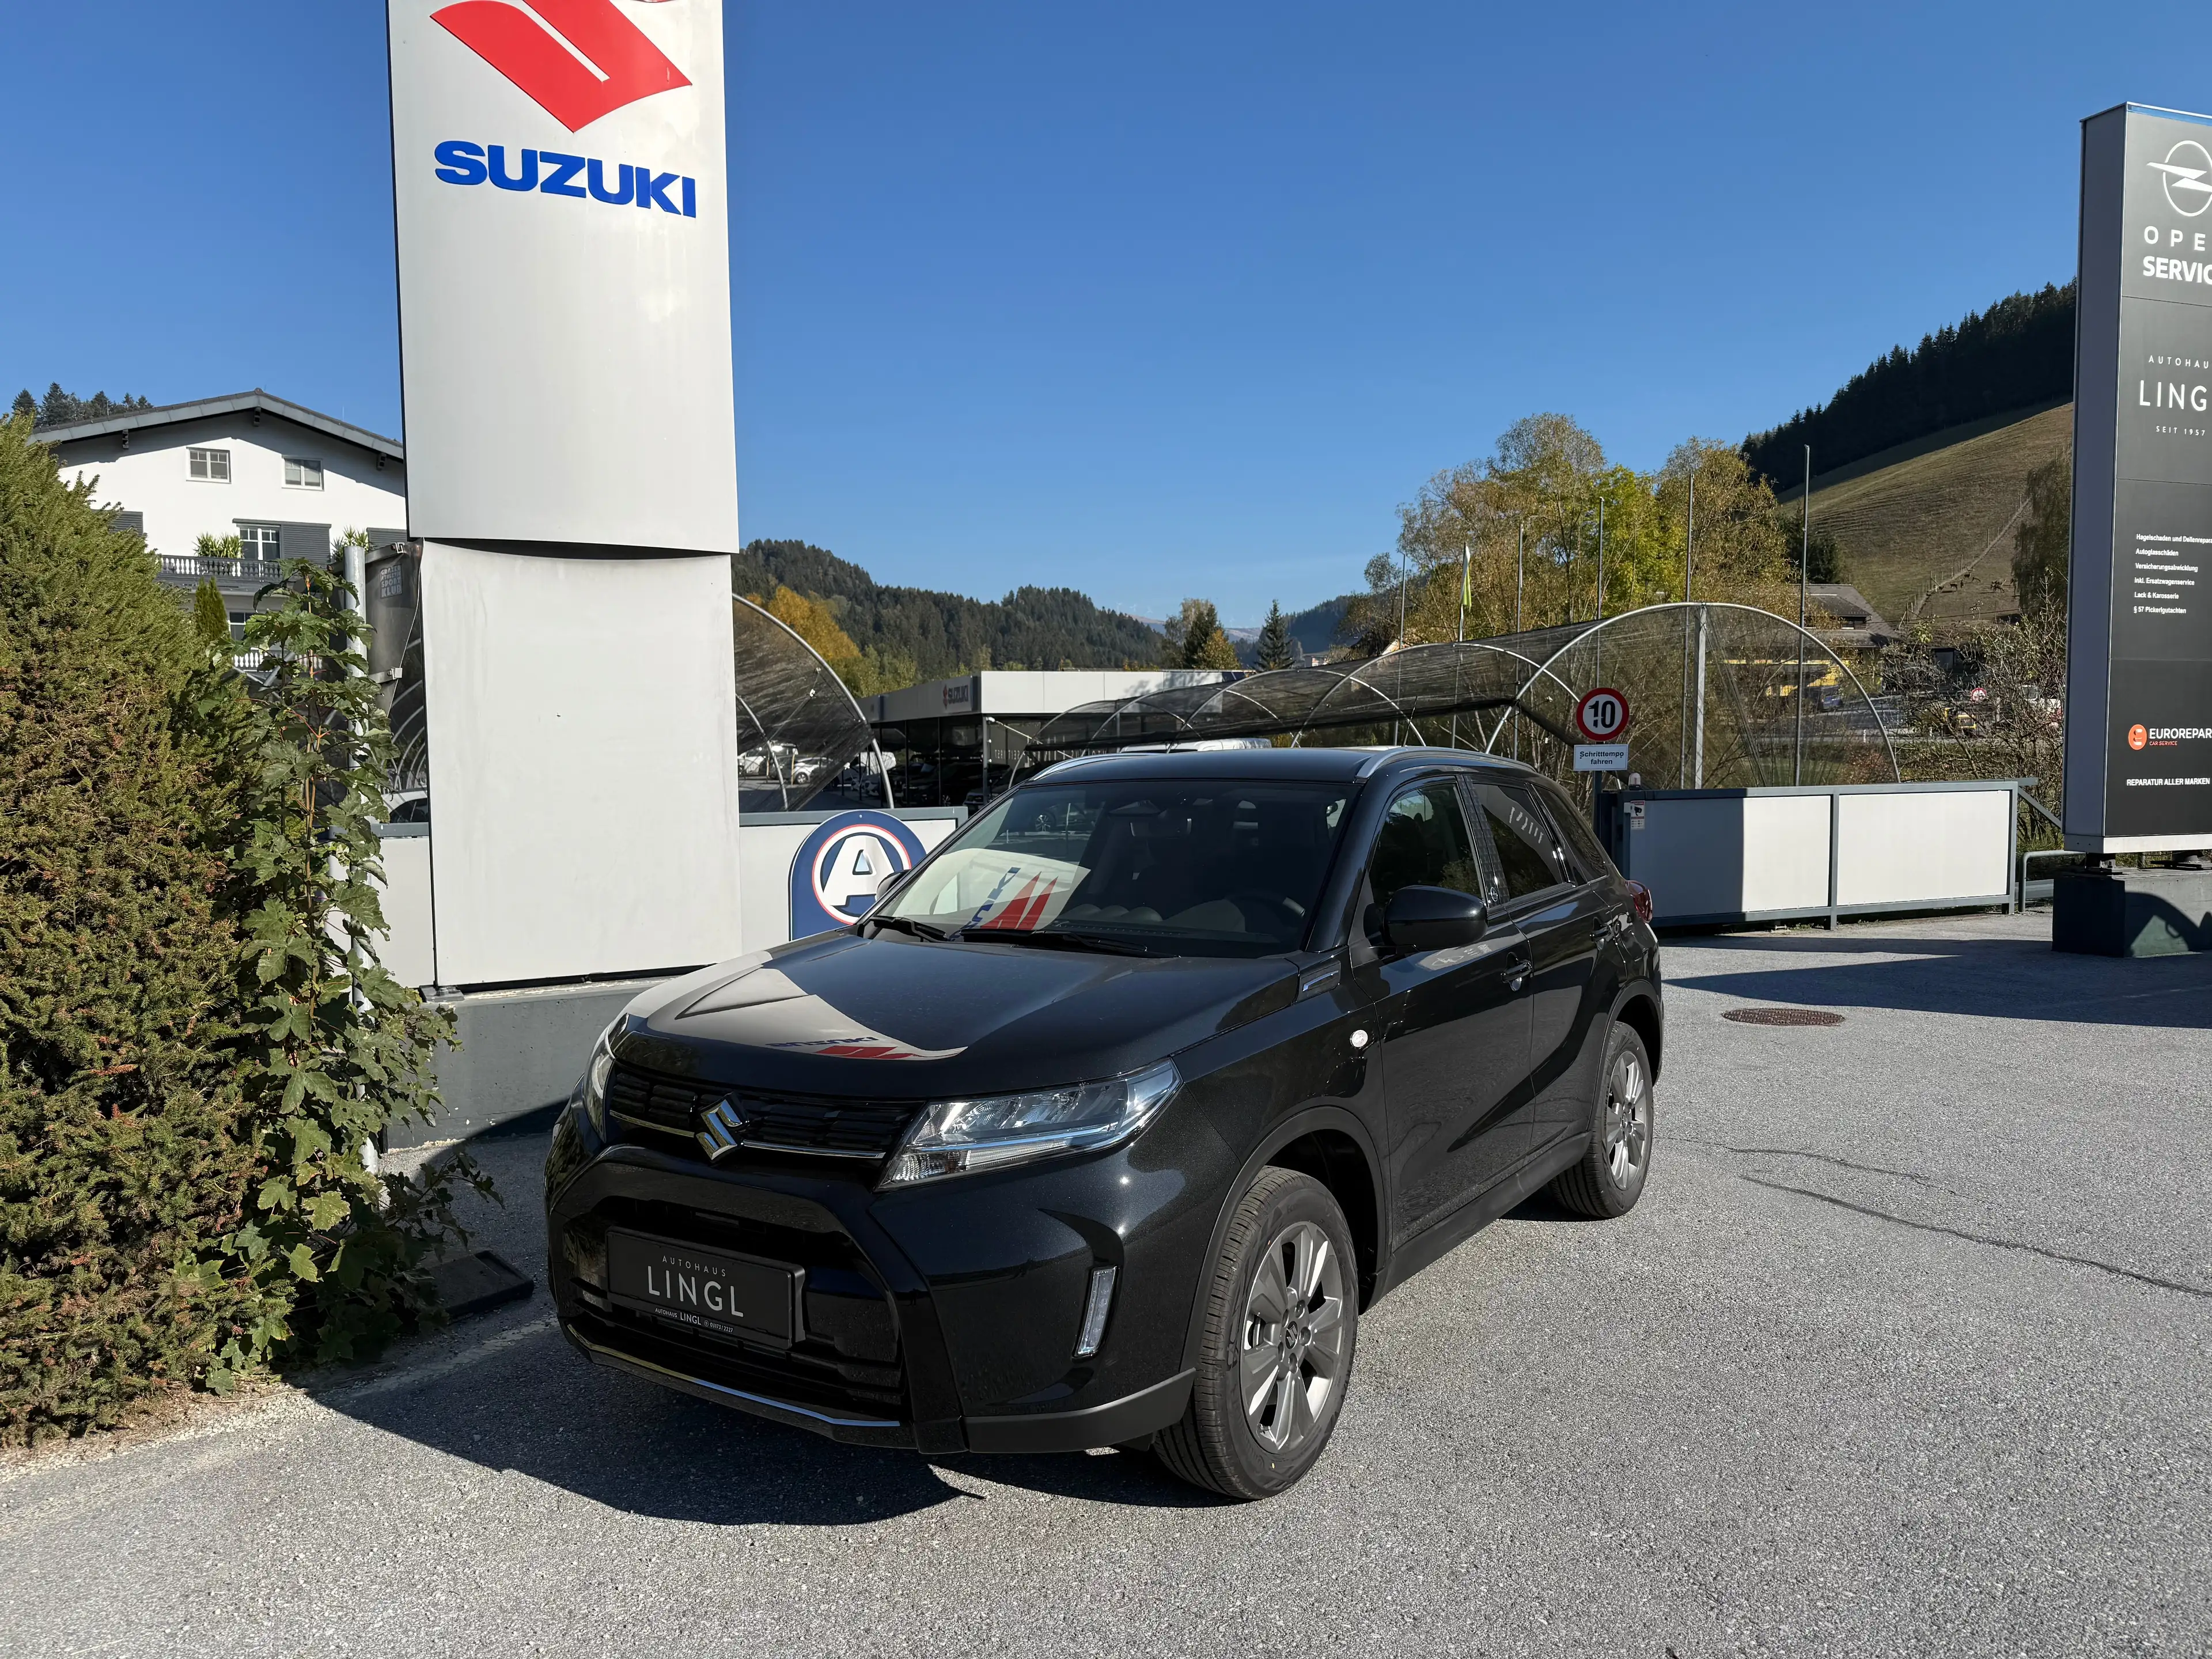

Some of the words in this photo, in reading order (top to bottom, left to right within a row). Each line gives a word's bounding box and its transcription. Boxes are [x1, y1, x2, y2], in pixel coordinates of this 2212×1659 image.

[434, 141, 696, 218] SUZUKI
[2156, 425, 2177, 434] SEIT
[2135, 548, 2179, 556] Autoglasschäden
[2135, 562, 2198, 573] Versicherungsabwicklung
[2146, 577, 2195, 586] Ersatzwagenservice
[948, 685, 968, 704] SUZUKI
[1588, 700, 1615, 728] 10
[2149, 728, 2212, 739] EUROREPAR
[662, 1255, 726, 1277] AUTOHAUS
[647, 1266, 744, 1317] LINGL
[655, 1308, 677, 1318] AUTOHAUS
[680, 1312, 702, 1325] LINGL
